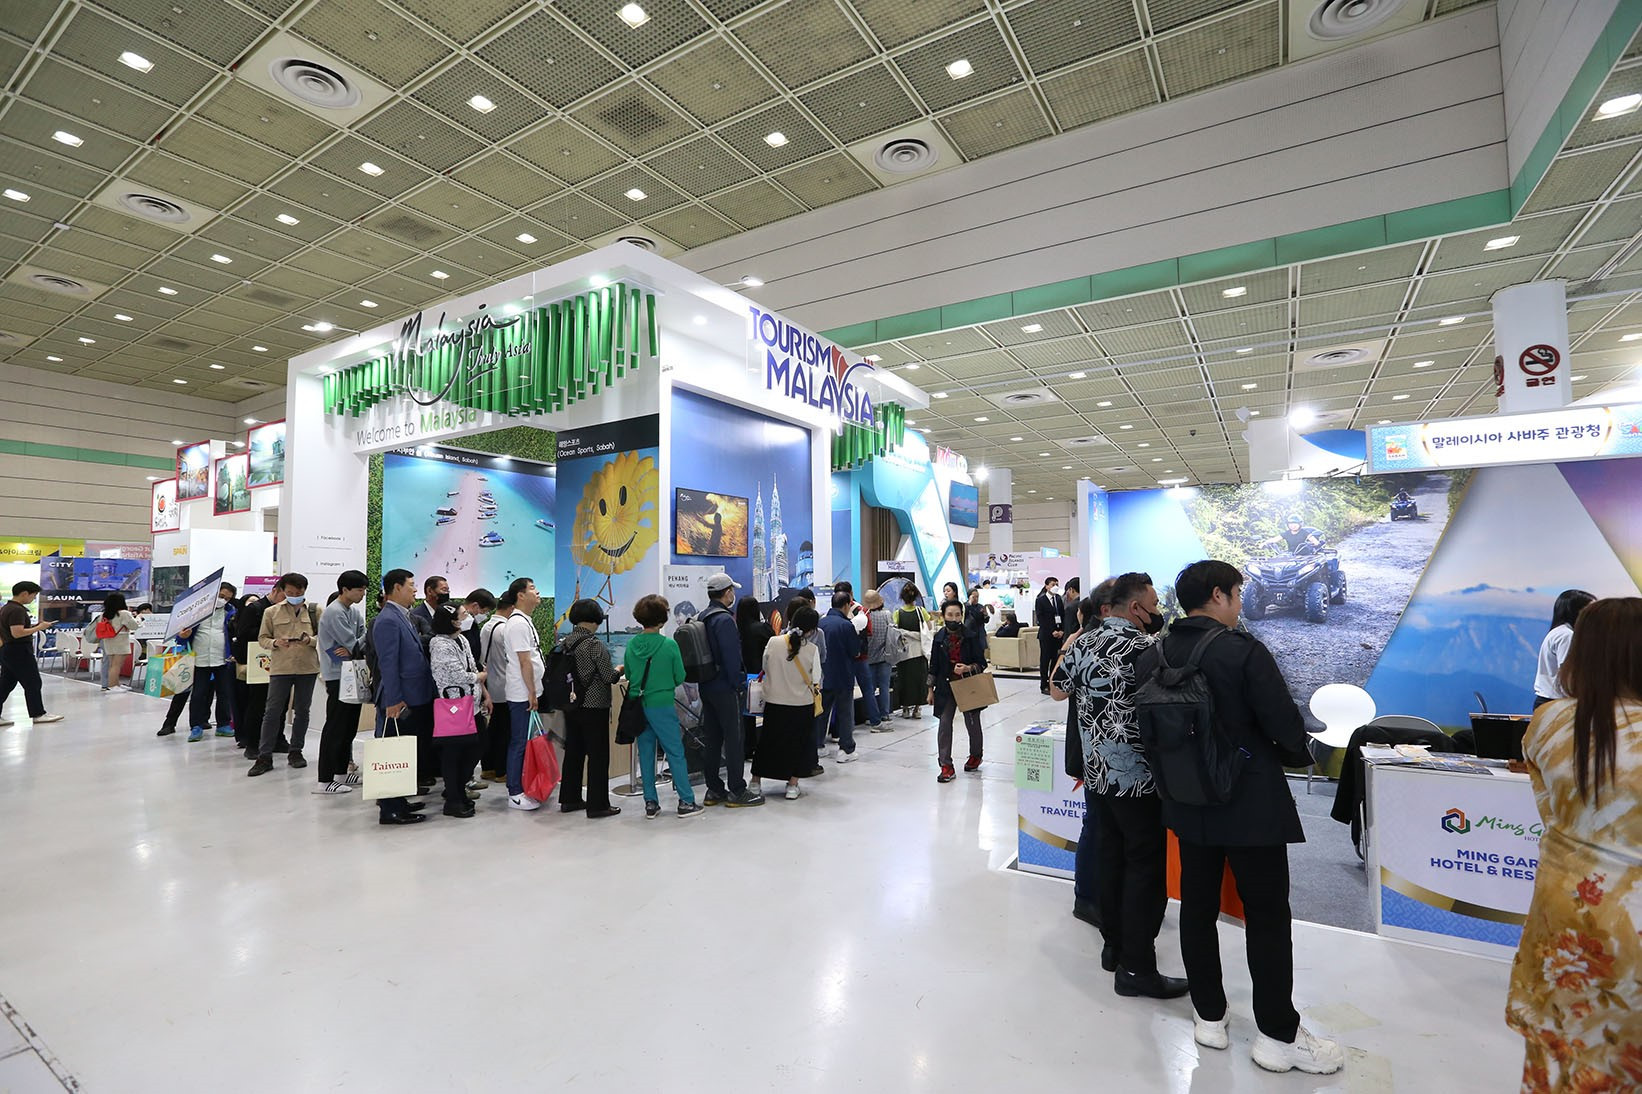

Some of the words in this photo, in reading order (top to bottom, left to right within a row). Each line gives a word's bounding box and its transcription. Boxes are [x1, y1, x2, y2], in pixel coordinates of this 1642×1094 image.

[505, 338, 532, 359] Asia
[749, 305, 831, 373] TOURISM
[394, 303, 520, 406] Malaysia
[766, 349, 875, 428] MALAYSIA
[1526, 376, 1555, 387] 금연
[356, 423, 401, 446] Welcome
[404, 421, 415, 436] to
[420, 406, 478, 434] Malaysia
[596, 442, 616, 451] Sabah)
[1432, 432, 1502, 449] 말레이시아
[1507, 429, 1549, 441] 사바주
[1555, 424, 1600, 440] 관광청
[372, 761, 409, 771] Taiwan
[1040, 806, 1080, 818] TRAVEL
[1062, 800, 1087, 810] TIME
[1475, 816, 1524, 836] Ming
[1457, 849, 1499, 863] MING
[1503, 855, 1539, 869] GAR
[1430, 858, 1483, 874] HOTEL
[1486, 865, 1498, 875] &
[1502, 867, 1535, 881] RES
